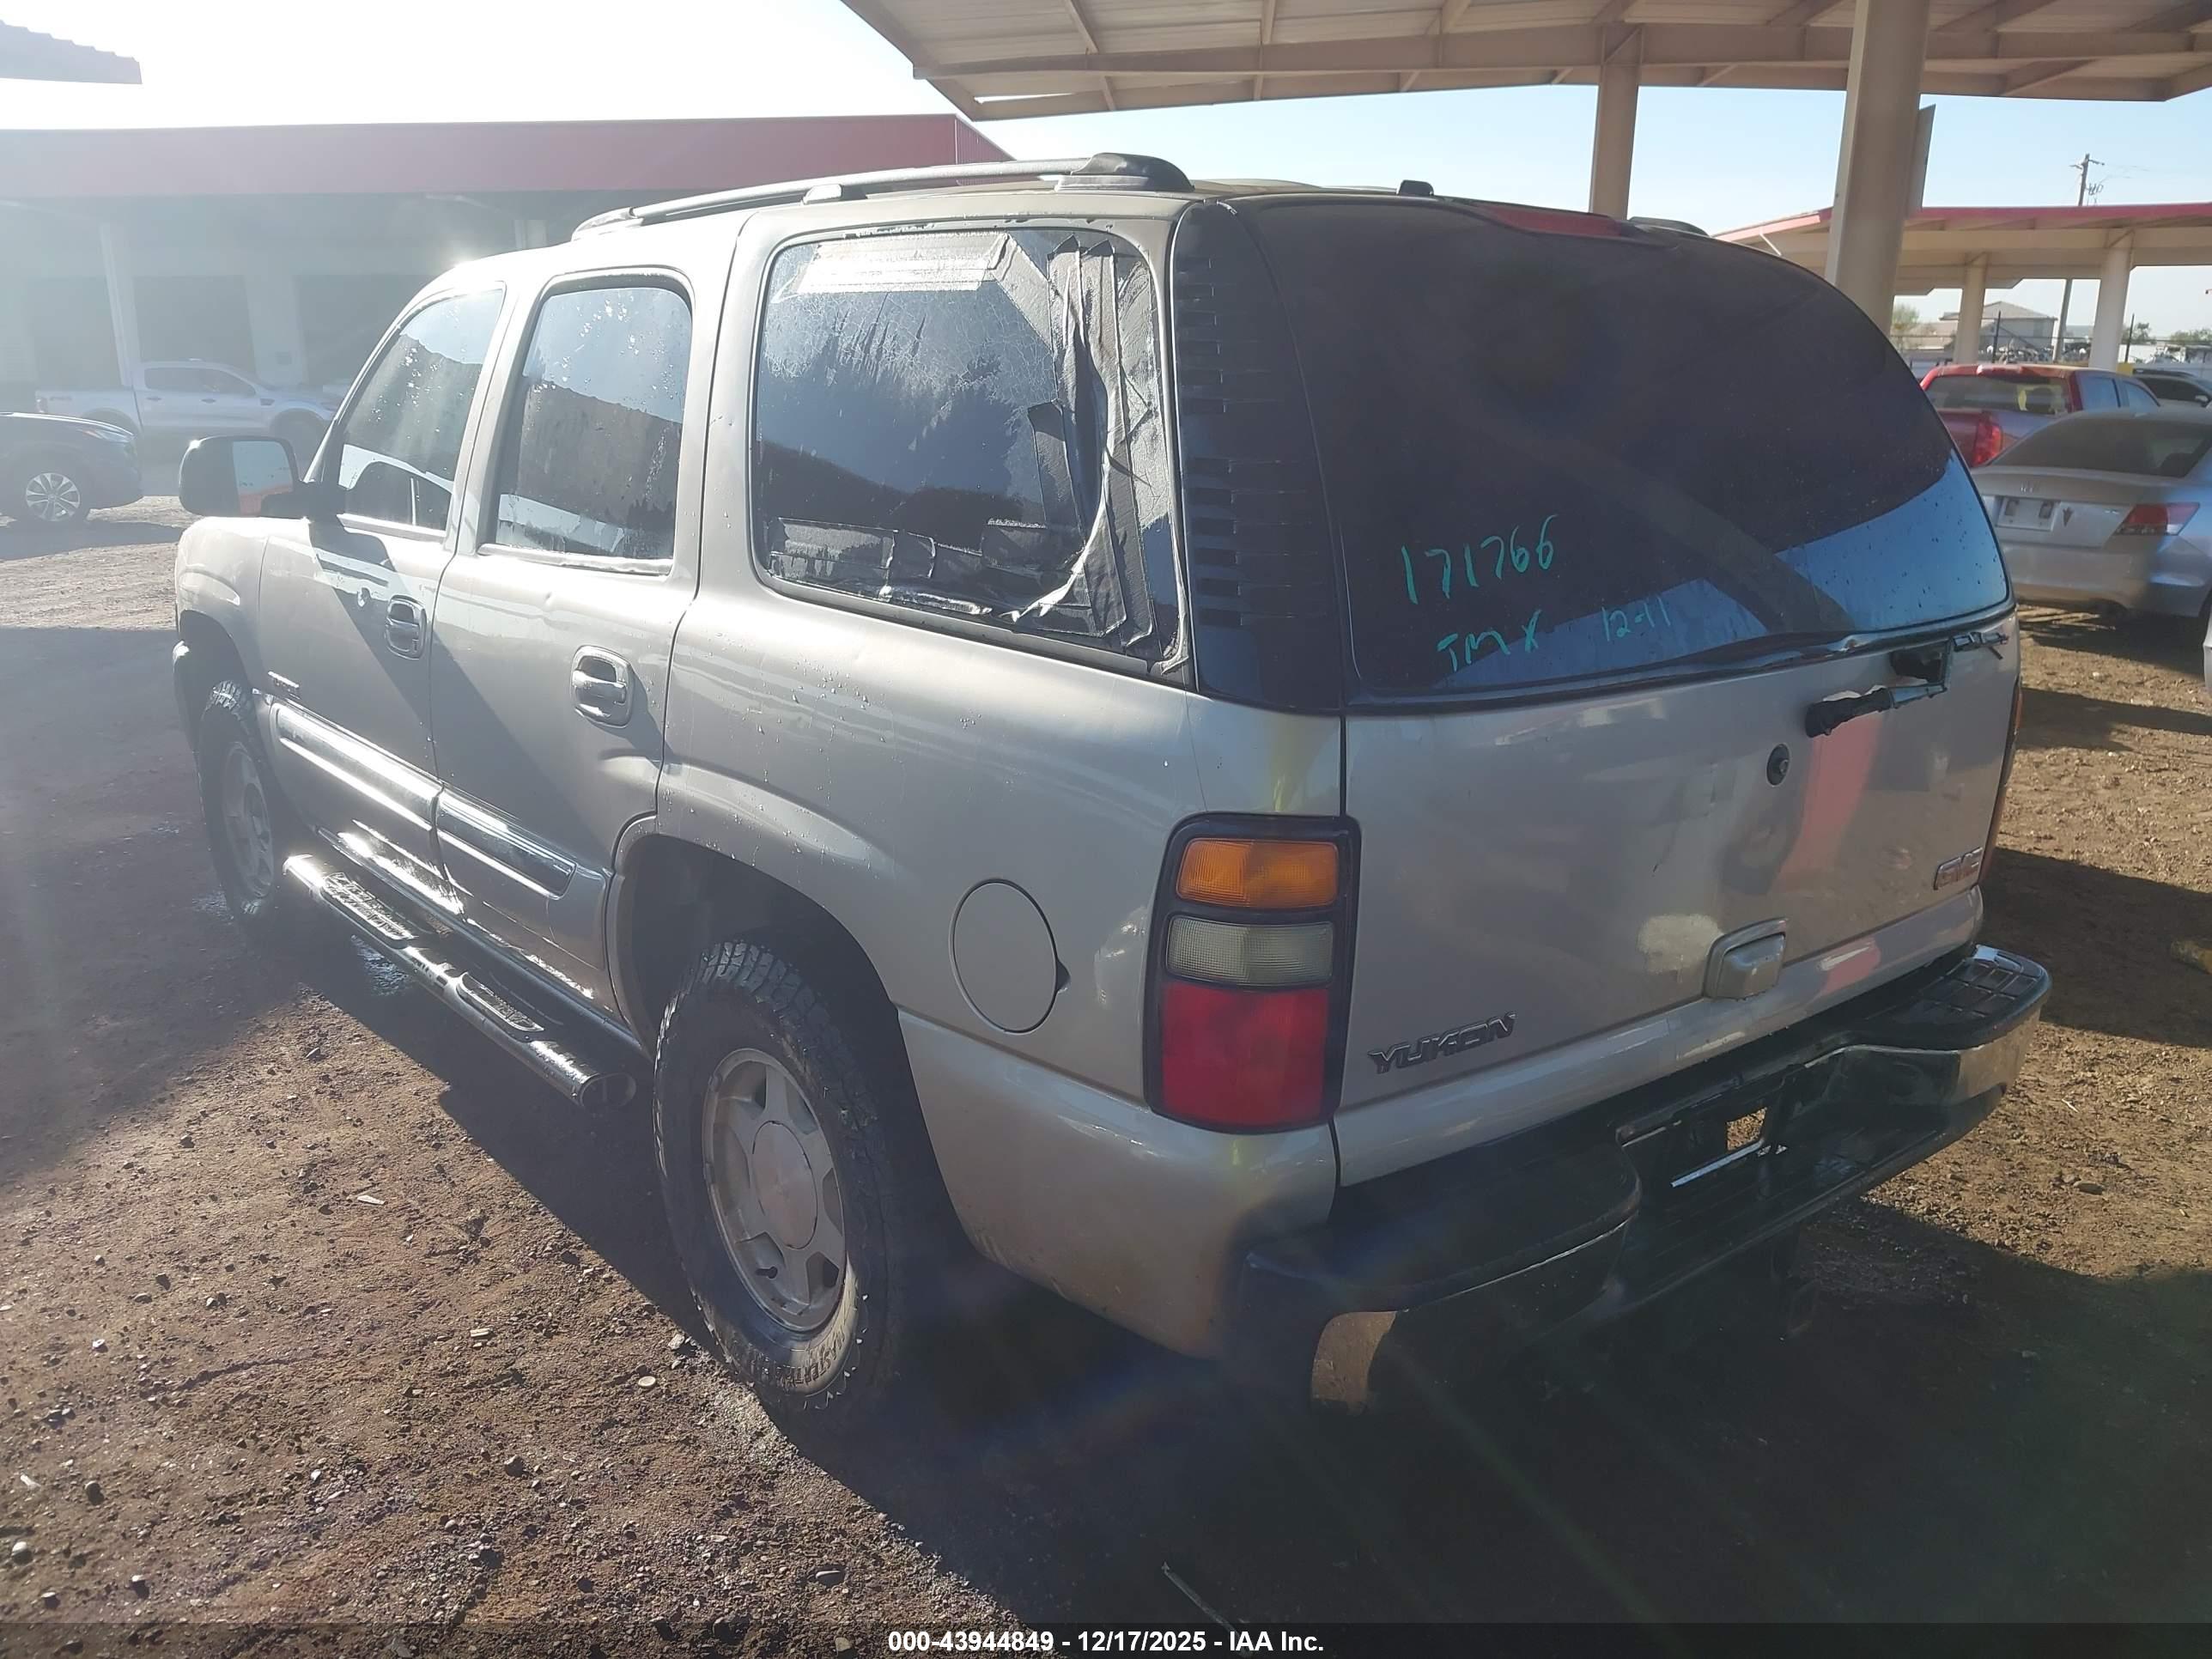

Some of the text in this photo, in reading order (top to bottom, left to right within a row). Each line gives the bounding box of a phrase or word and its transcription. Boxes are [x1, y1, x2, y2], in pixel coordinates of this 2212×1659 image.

[1401, 514, 1558, 605] 171766
[1601, 597, 1672, 641] 12-11
[1367, 1012, 1517, 1074] YUKON
